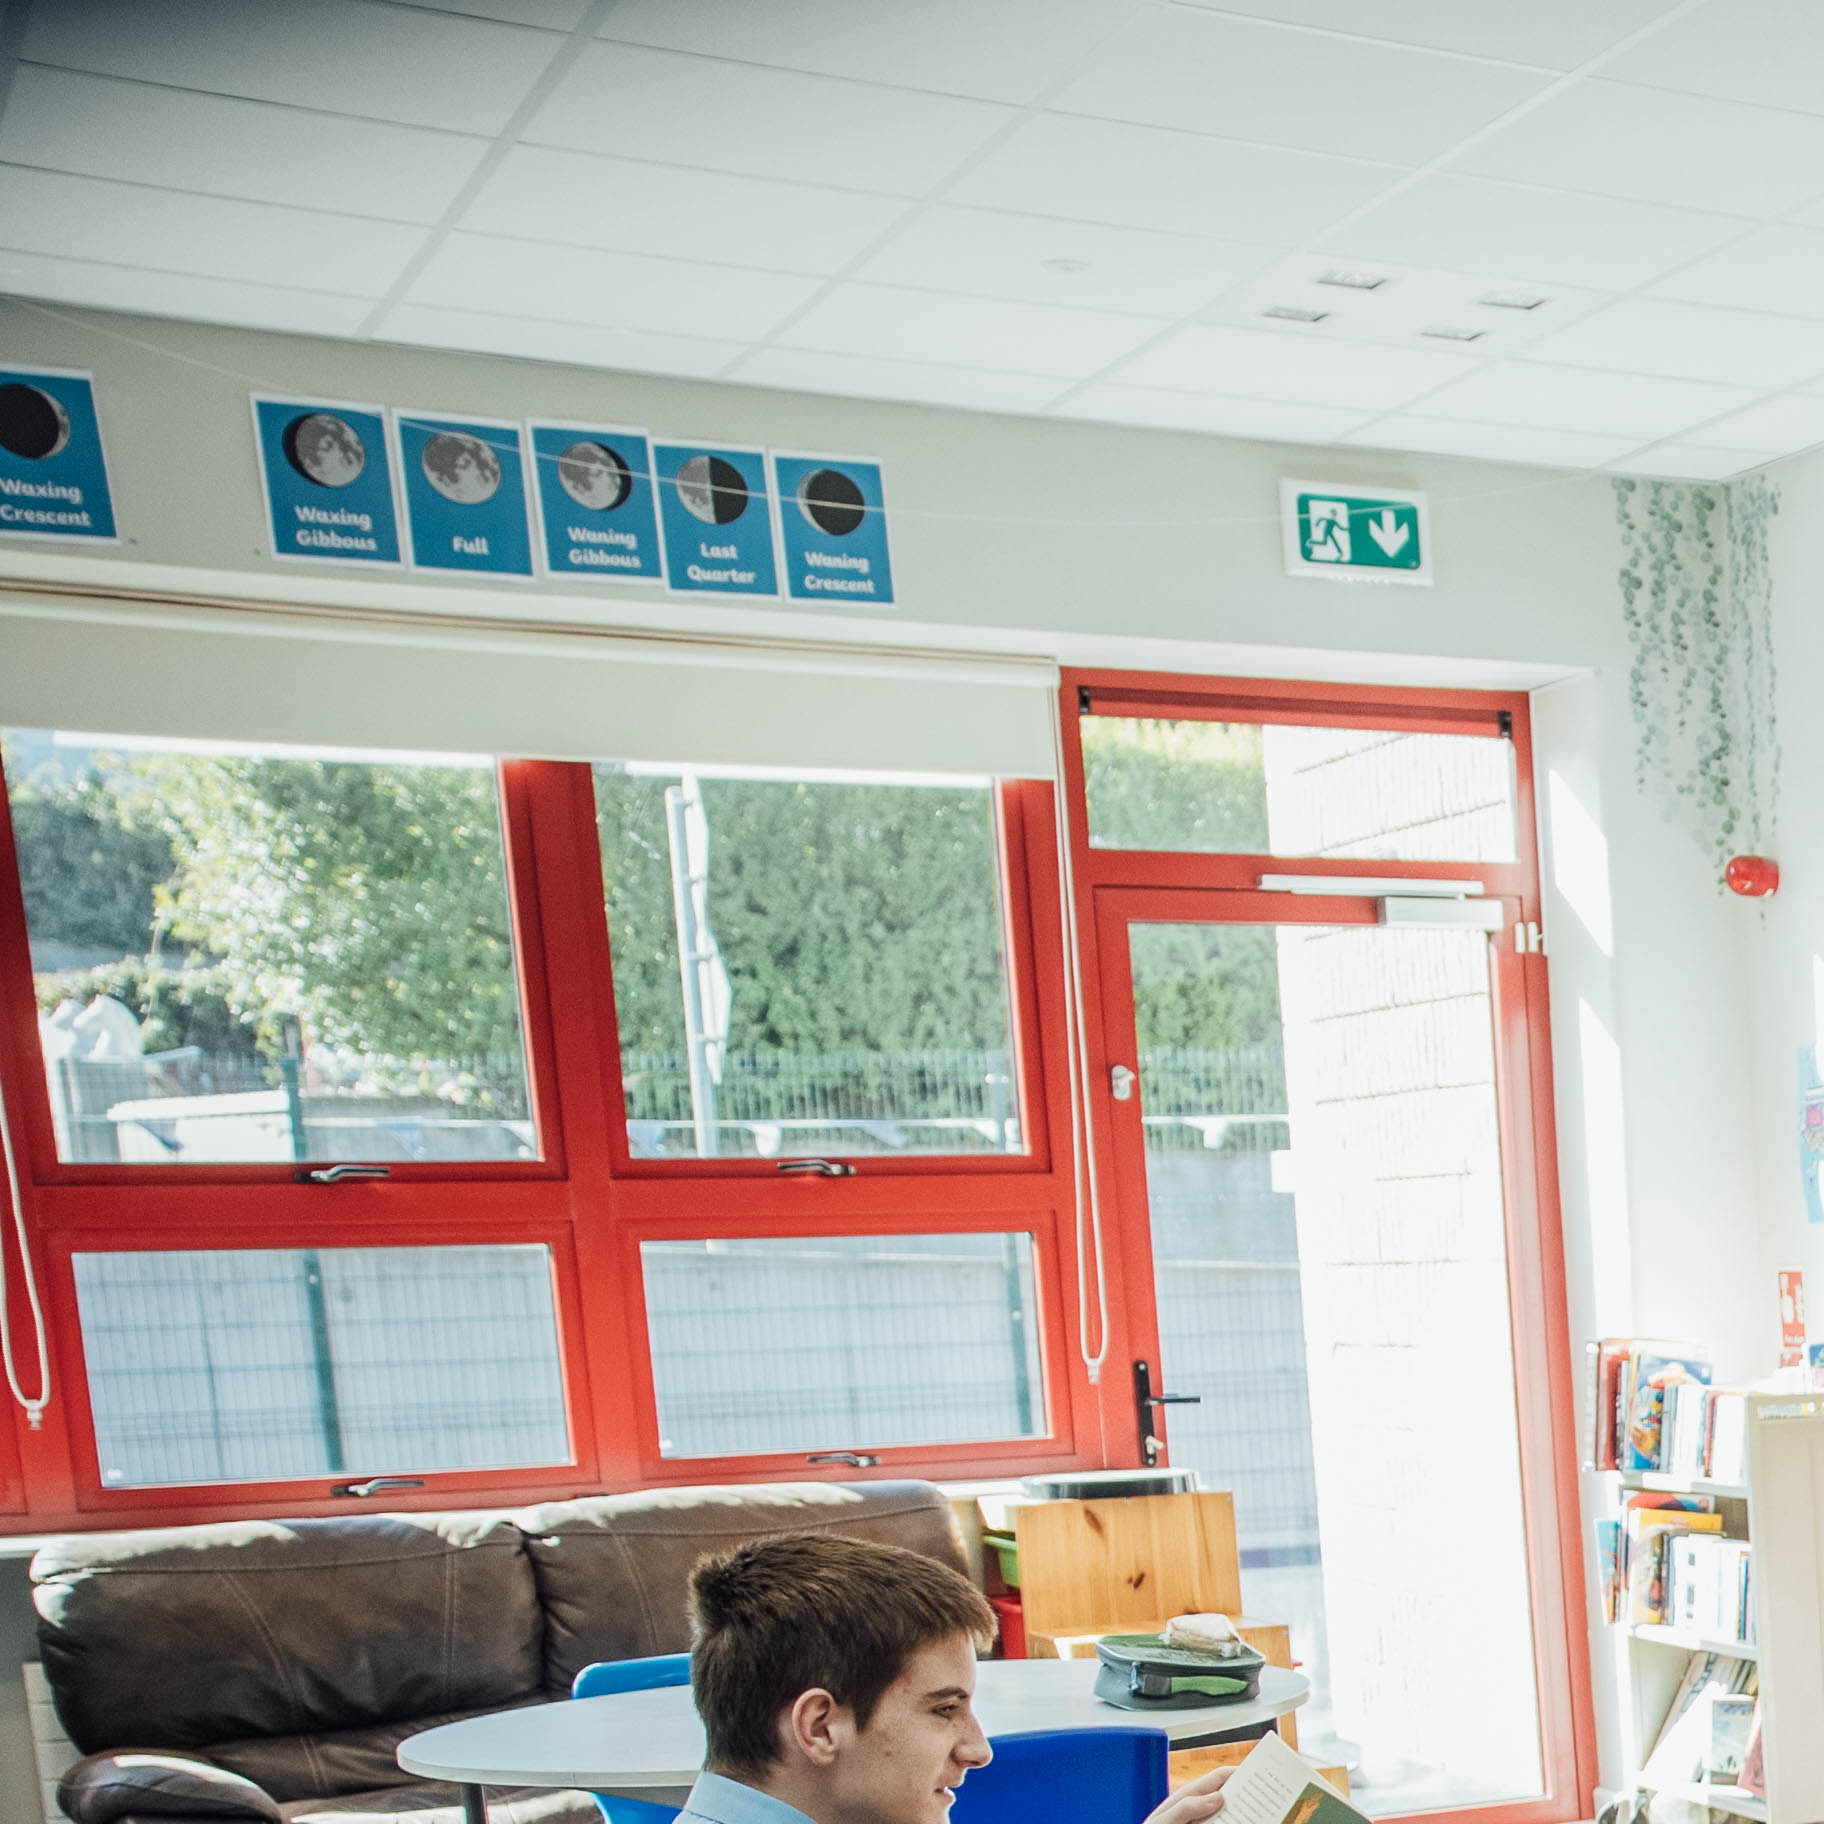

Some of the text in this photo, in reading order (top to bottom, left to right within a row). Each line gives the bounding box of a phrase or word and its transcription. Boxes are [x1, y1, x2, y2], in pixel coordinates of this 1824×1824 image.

[0, 478, 81, 502] Waxing
[0, 506, 90, 527] Crescent
[295, 504, 372, 531] Waxing
[297, 529, 377, 551] Gibbous
[453, 536, 489, 556] Full
[567, 526, 637, 550] Waning
[569, 548, 642, 569] Gibbous
[700, 542, 738, 560] Last
[804, 551, 870, 574] Waning
[687, 563, 756, 585] Quarter
[804, 573, 875, 594] Crescent
